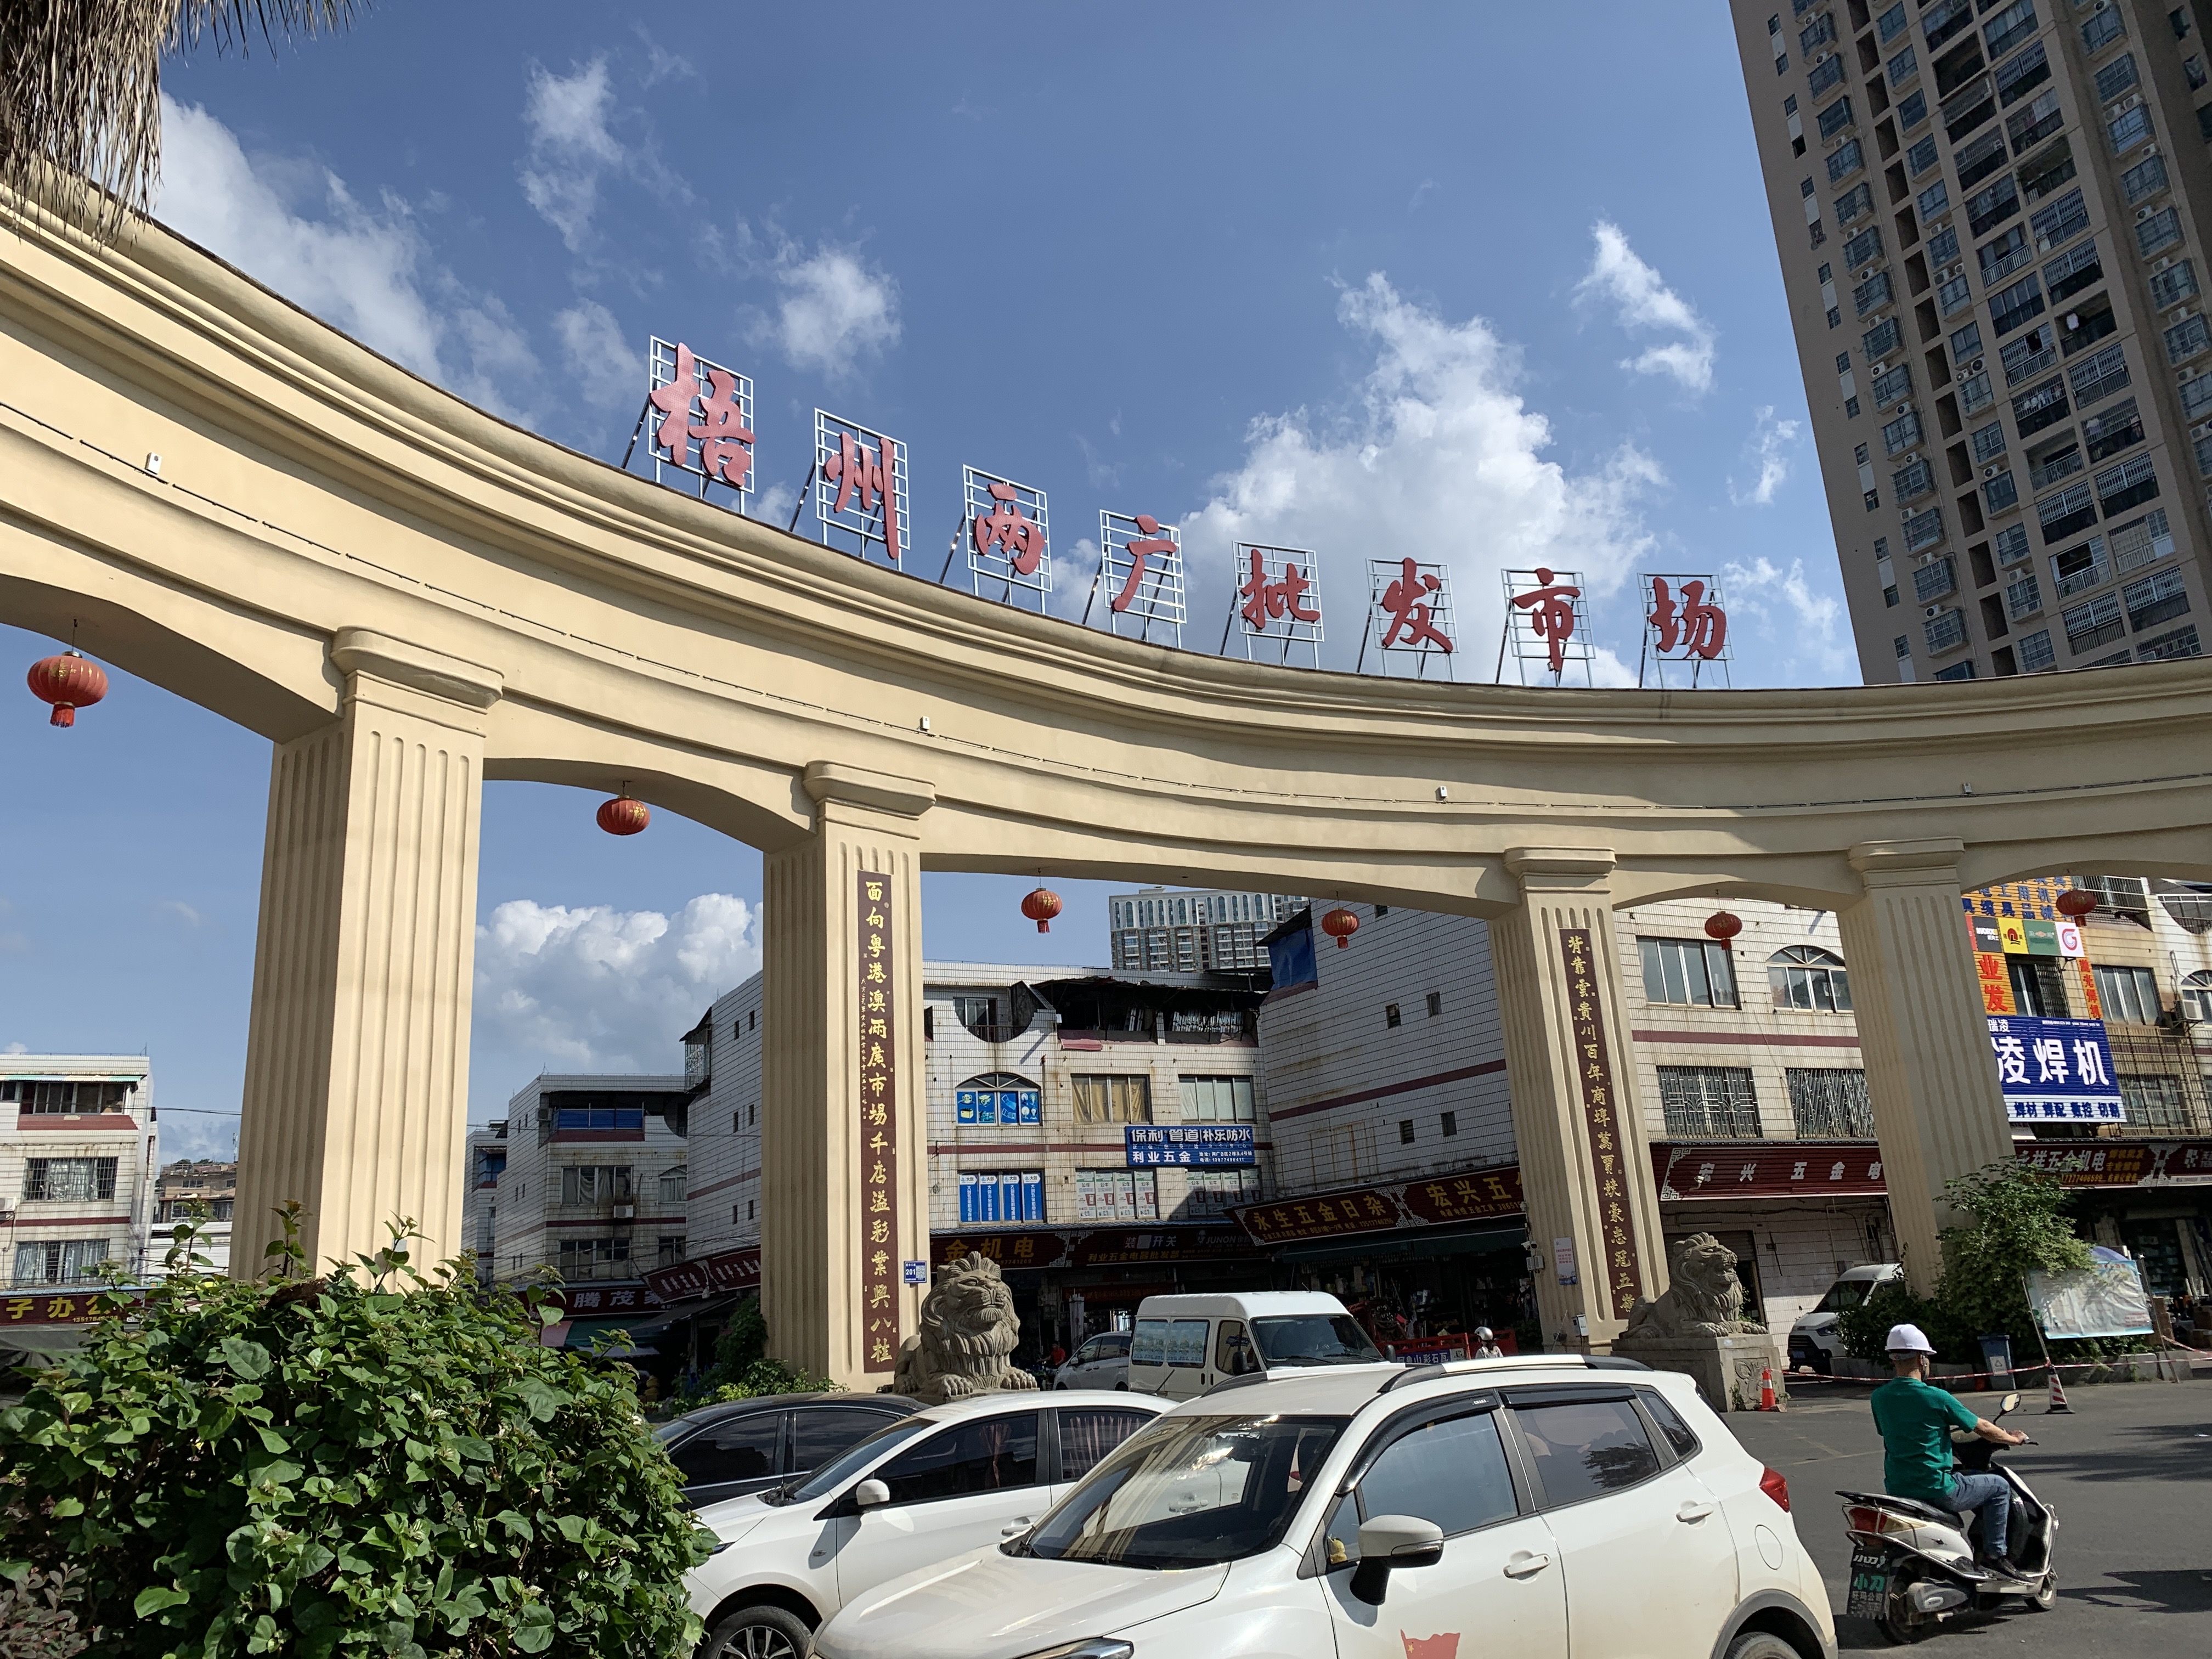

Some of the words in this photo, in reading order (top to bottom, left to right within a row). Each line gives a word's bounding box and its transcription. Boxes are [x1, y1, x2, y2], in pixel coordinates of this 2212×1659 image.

[1131, 1129, 1163, 1142] 保利
[1169, 1129, 1200, 1142] 管道
[1132, 1151, 1191, 1163] 利业五金
[1254, 1195, 1387, 1232] 永生五金日杂
[1206, 1235, 1237, 1244] JUNON
[1088, 1250, 1180, 1262] 利业五金电器批发部
